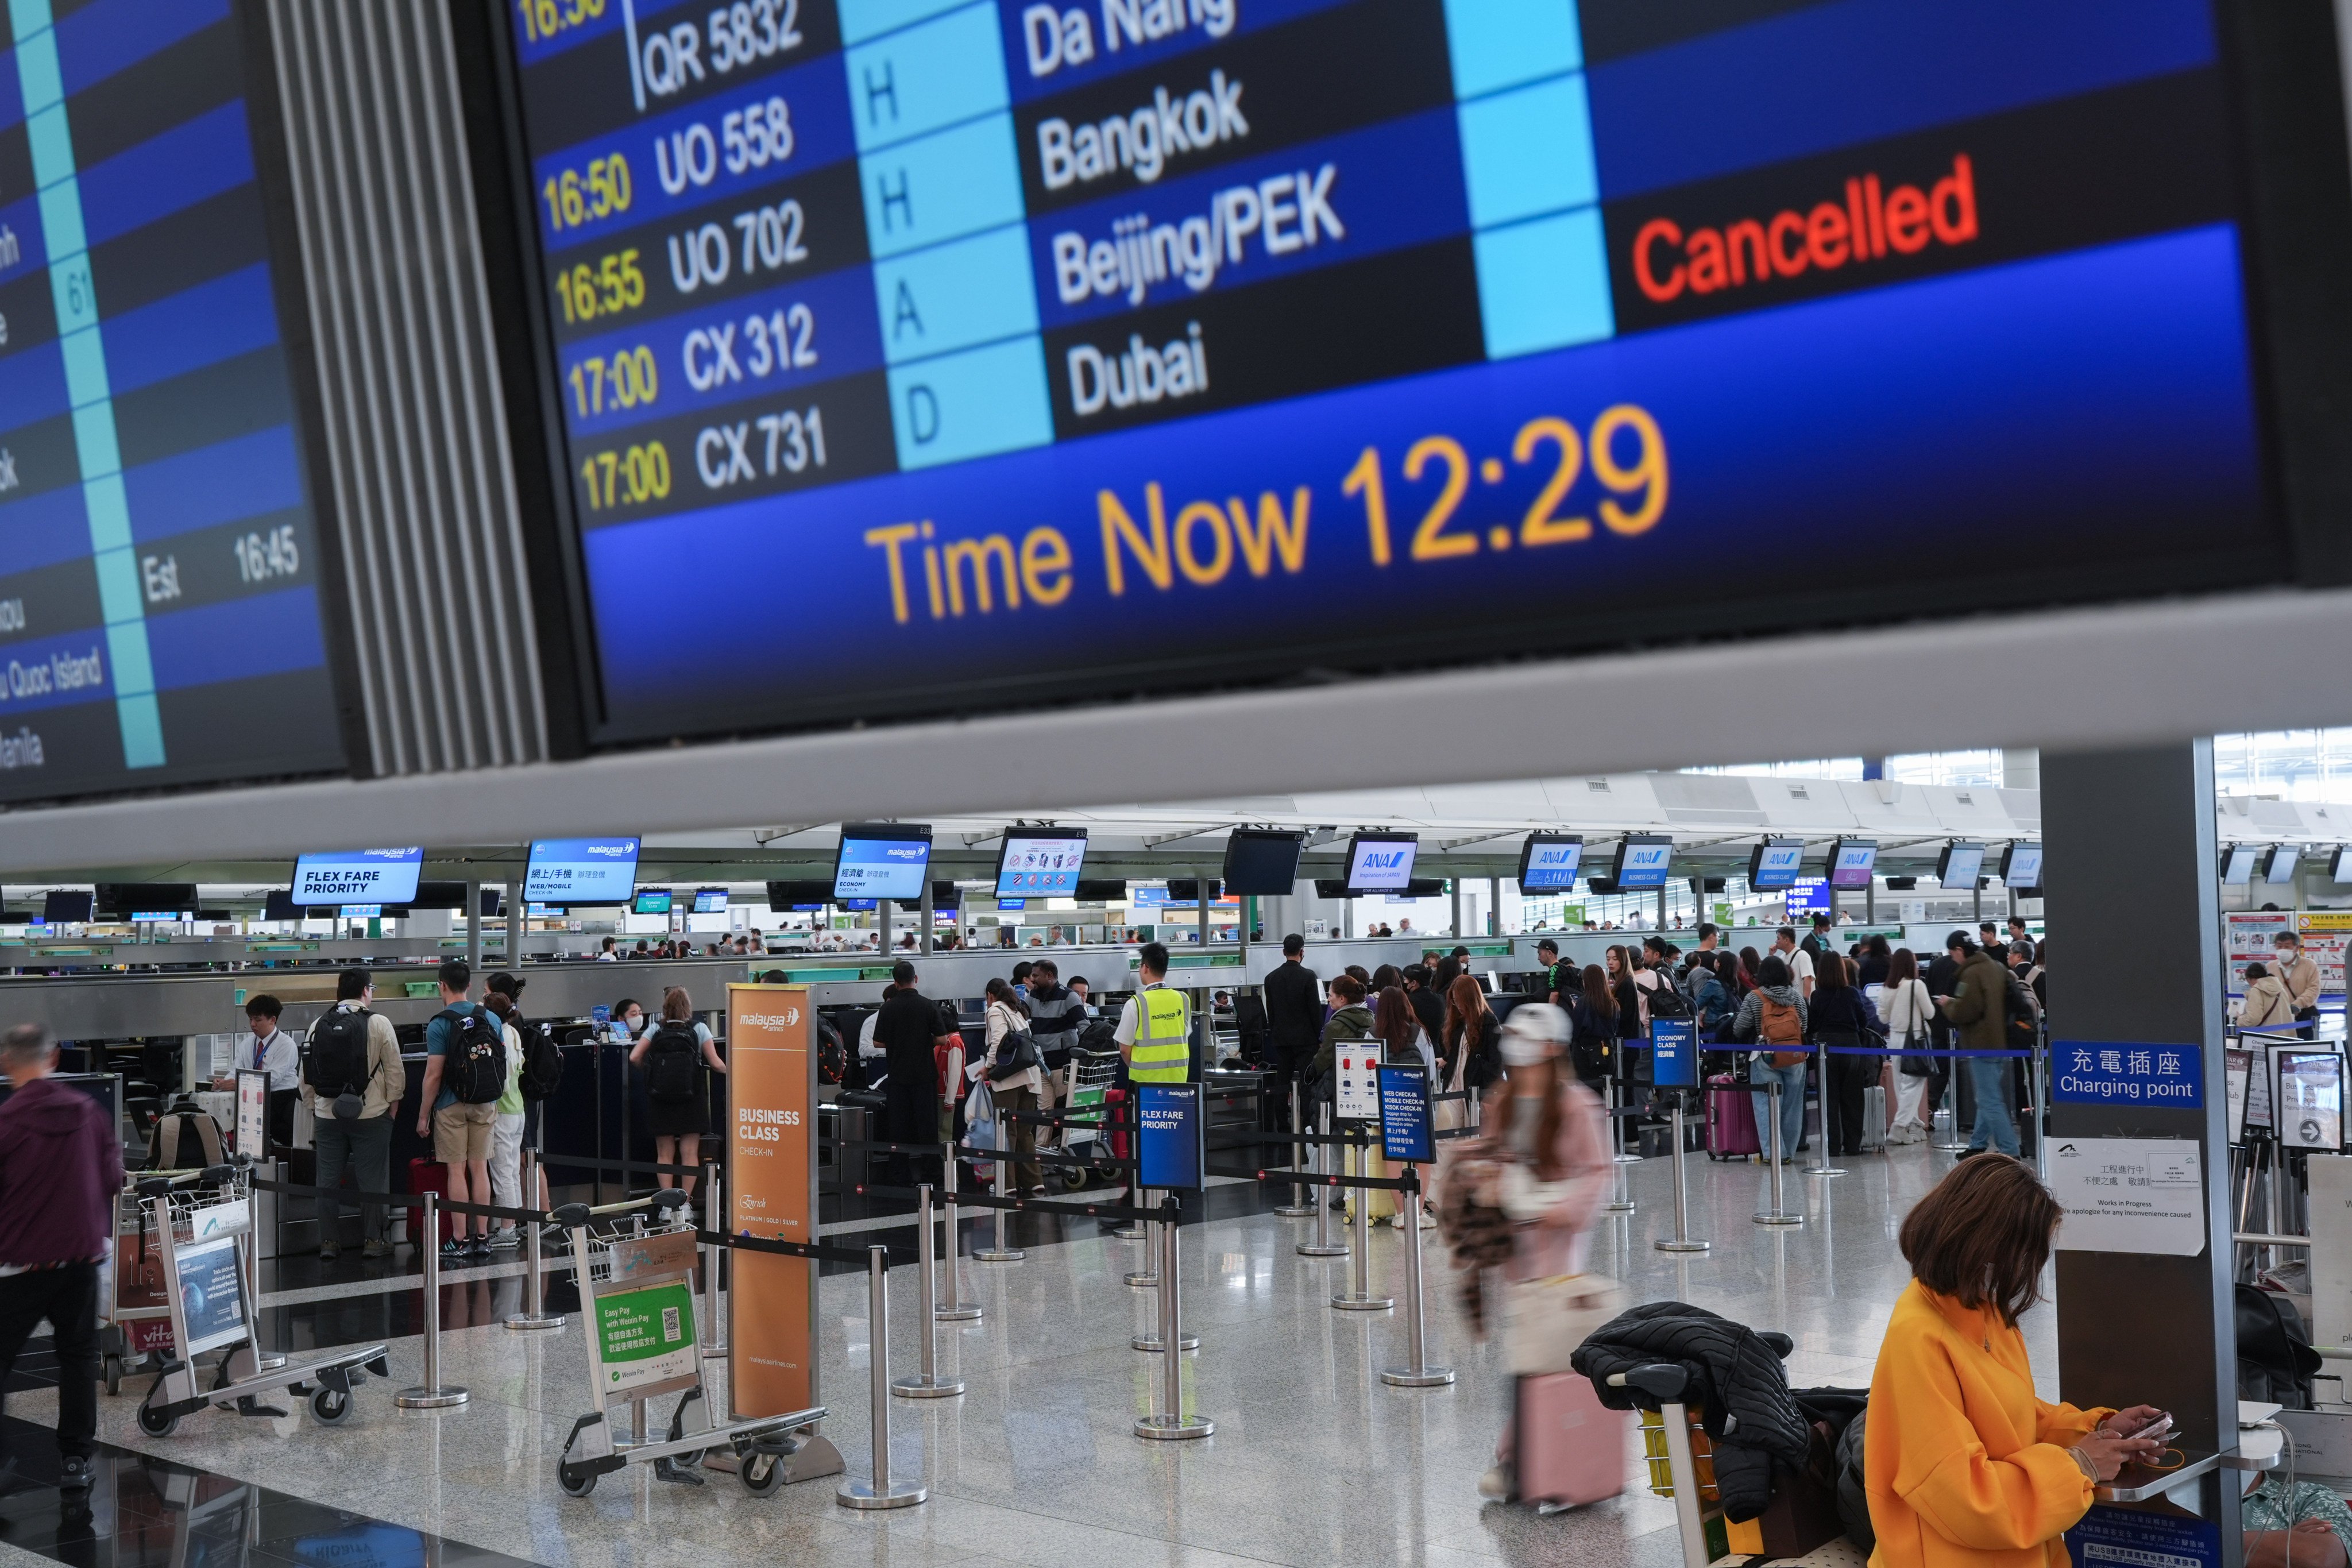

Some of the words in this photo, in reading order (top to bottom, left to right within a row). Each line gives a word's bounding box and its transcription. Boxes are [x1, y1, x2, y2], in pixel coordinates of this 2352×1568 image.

[643, 22, 705, 95] QR
[709, 0, 802, 72] 5832
[543, 153, 632, 230] 16:50
[656, 123, 716, 195] UO
[723, 97, 794, 173] 558
[864, 59, 898, 129] H
[1022, 4, 1094, 77] Da
[1102, 0, 1238, 52] Nang
[555, 249, 645, 323] 16:55
[668, 223, 729, 293] UO
[735, 200, 808, 273] 702
[878, 168, 913, 234] H
[1037, 69, 1249, 190] Bangkok
[569, 346, 658, 418] 17:00
[683, 329, 742, 391] CX
[747, 303, 817, 376] 312
[894, 279, 924, 341] A
[1052, 163, 1346, 305] Beijing/PEK
[582, 441, 671, 510] 17:00
[696, 422, 755, 488] CX
[758, 406, 827, 476] 731
[907, 384, 941, 445] D
[1067, 320, 1210, 416] Dubai
[1633, 152, 1979, 303] Cancelled
[865, 521, 1073, 624] Time
[1098, 481, 1311, 596] Now
[1341, 404, 1670, 565] 12:29
[144, 555, 181, 602] Est
[235, 525, 300, 582] 16:45
[51, 646, 103, 690] Island
[364, 847, 405, 857] malaysia
[588, 845, 623, 856] malaysia
[887, 848, 916, 859] malaysia
[1362, 853, 1390, 868] ANA
[1539, 851, 1561, 863] ANA
[1632, 852, 1653, 864] ANA
[1768, 854, 1786, 864] ANA
[1844, 854, 1860, 864] ANA
[306, 872, 341, 881] FLEX
[344, 871, 380, 880] FARE
[531, 869, 572, 879] 網上/手機
[304, 883, 368, 893] PRIORITY
[1575, 907, 1583, 921] 1
[1725, 906, 1733, 920] 2
[740, 1013, 785, 1029] malaysia
[1151, 1013, 1175, 1021] malaysia
[2071, 1048, 2181, 1075] 充電插座
[2061, 1076, 2139, 1098] Charging
[2147, 1080, 2193, 1099] point
[739, 1108, 800, 1125] BUSINESS
[1141, 1110, 1161, 1118] FLEX
[1163, 1111, 1184, 1119] FARE
[1141, 1121, 1177, 1129] PRIORITY
[739, 1125, 779, 1141] CLASS
[739, 1146, 773, 1157] CHECK-IN
[2100, 1165, 2144, 1175] 工程進行中
[2083, 1176, 2118, 1186] 不便之處
[739, 1195, 766, 1210] Enrich
[2072, 1208, 2100, 1216] apologize
[605, 1309, 618, 1318] Easy
[619, 1307, 630, 1315] Pay
[606, 1320, 619, 1328] with
[619, 1317, 638, 1326] Weixin
[639, 1315, 649, 1323] Pay
[749, 1356, 797, 1369] malaysiaairlines.com
[622, 1370, 636, 1378] Weixin
